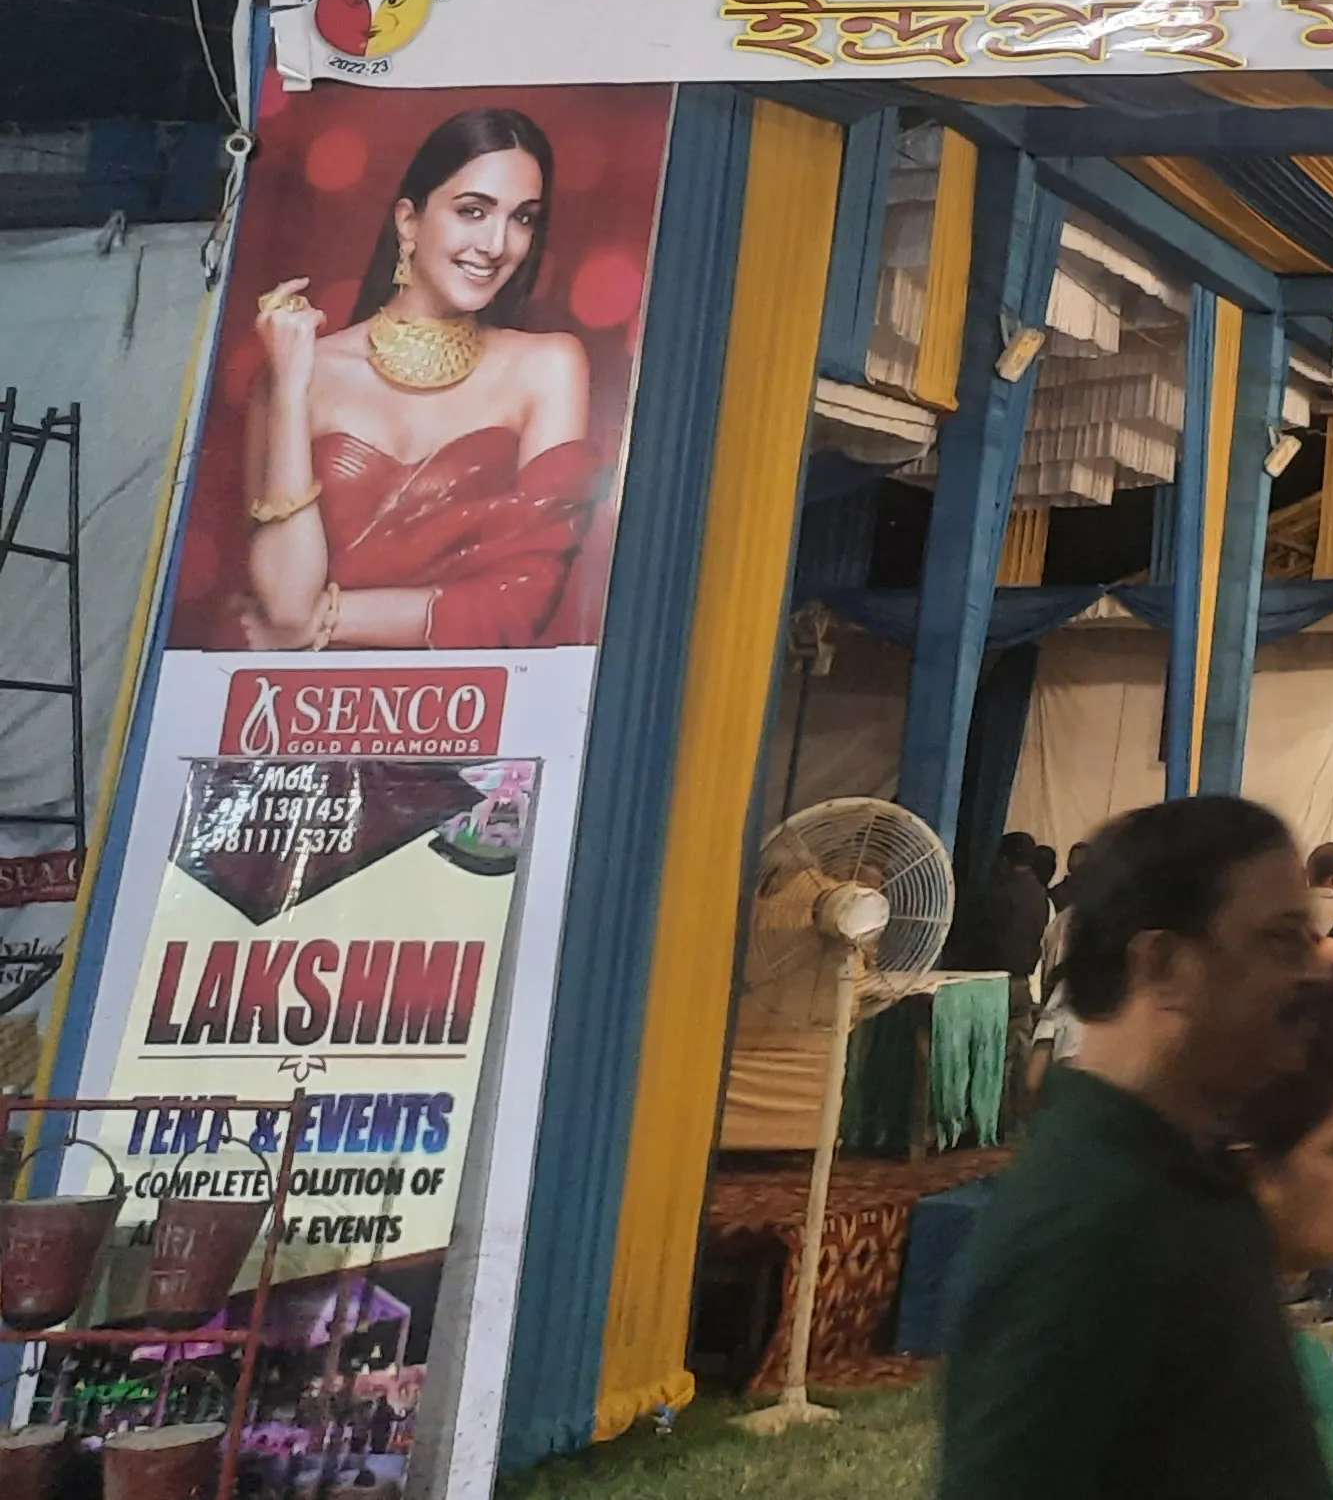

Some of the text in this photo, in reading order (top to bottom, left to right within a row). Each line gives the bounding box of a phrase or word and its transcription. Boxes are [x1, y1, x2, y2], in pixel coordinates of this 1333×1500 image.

[289, 684, 487, 735] SENCO
[286, 739, 481, 755] GOLD & DIAMONDS
[144, 938, 486, 1046] LAKSHMI
[127, 1095, 237, 1155] TENT
[296, 1092, 454, 1155] EVENTS
[135, 1169, 269, 1199] COMPLETE
[280, 1167, 404, 1197] OLUTION
[410, 1166, 446, 1196] OF
[306, 1214, 402, 1245] EVENTS
